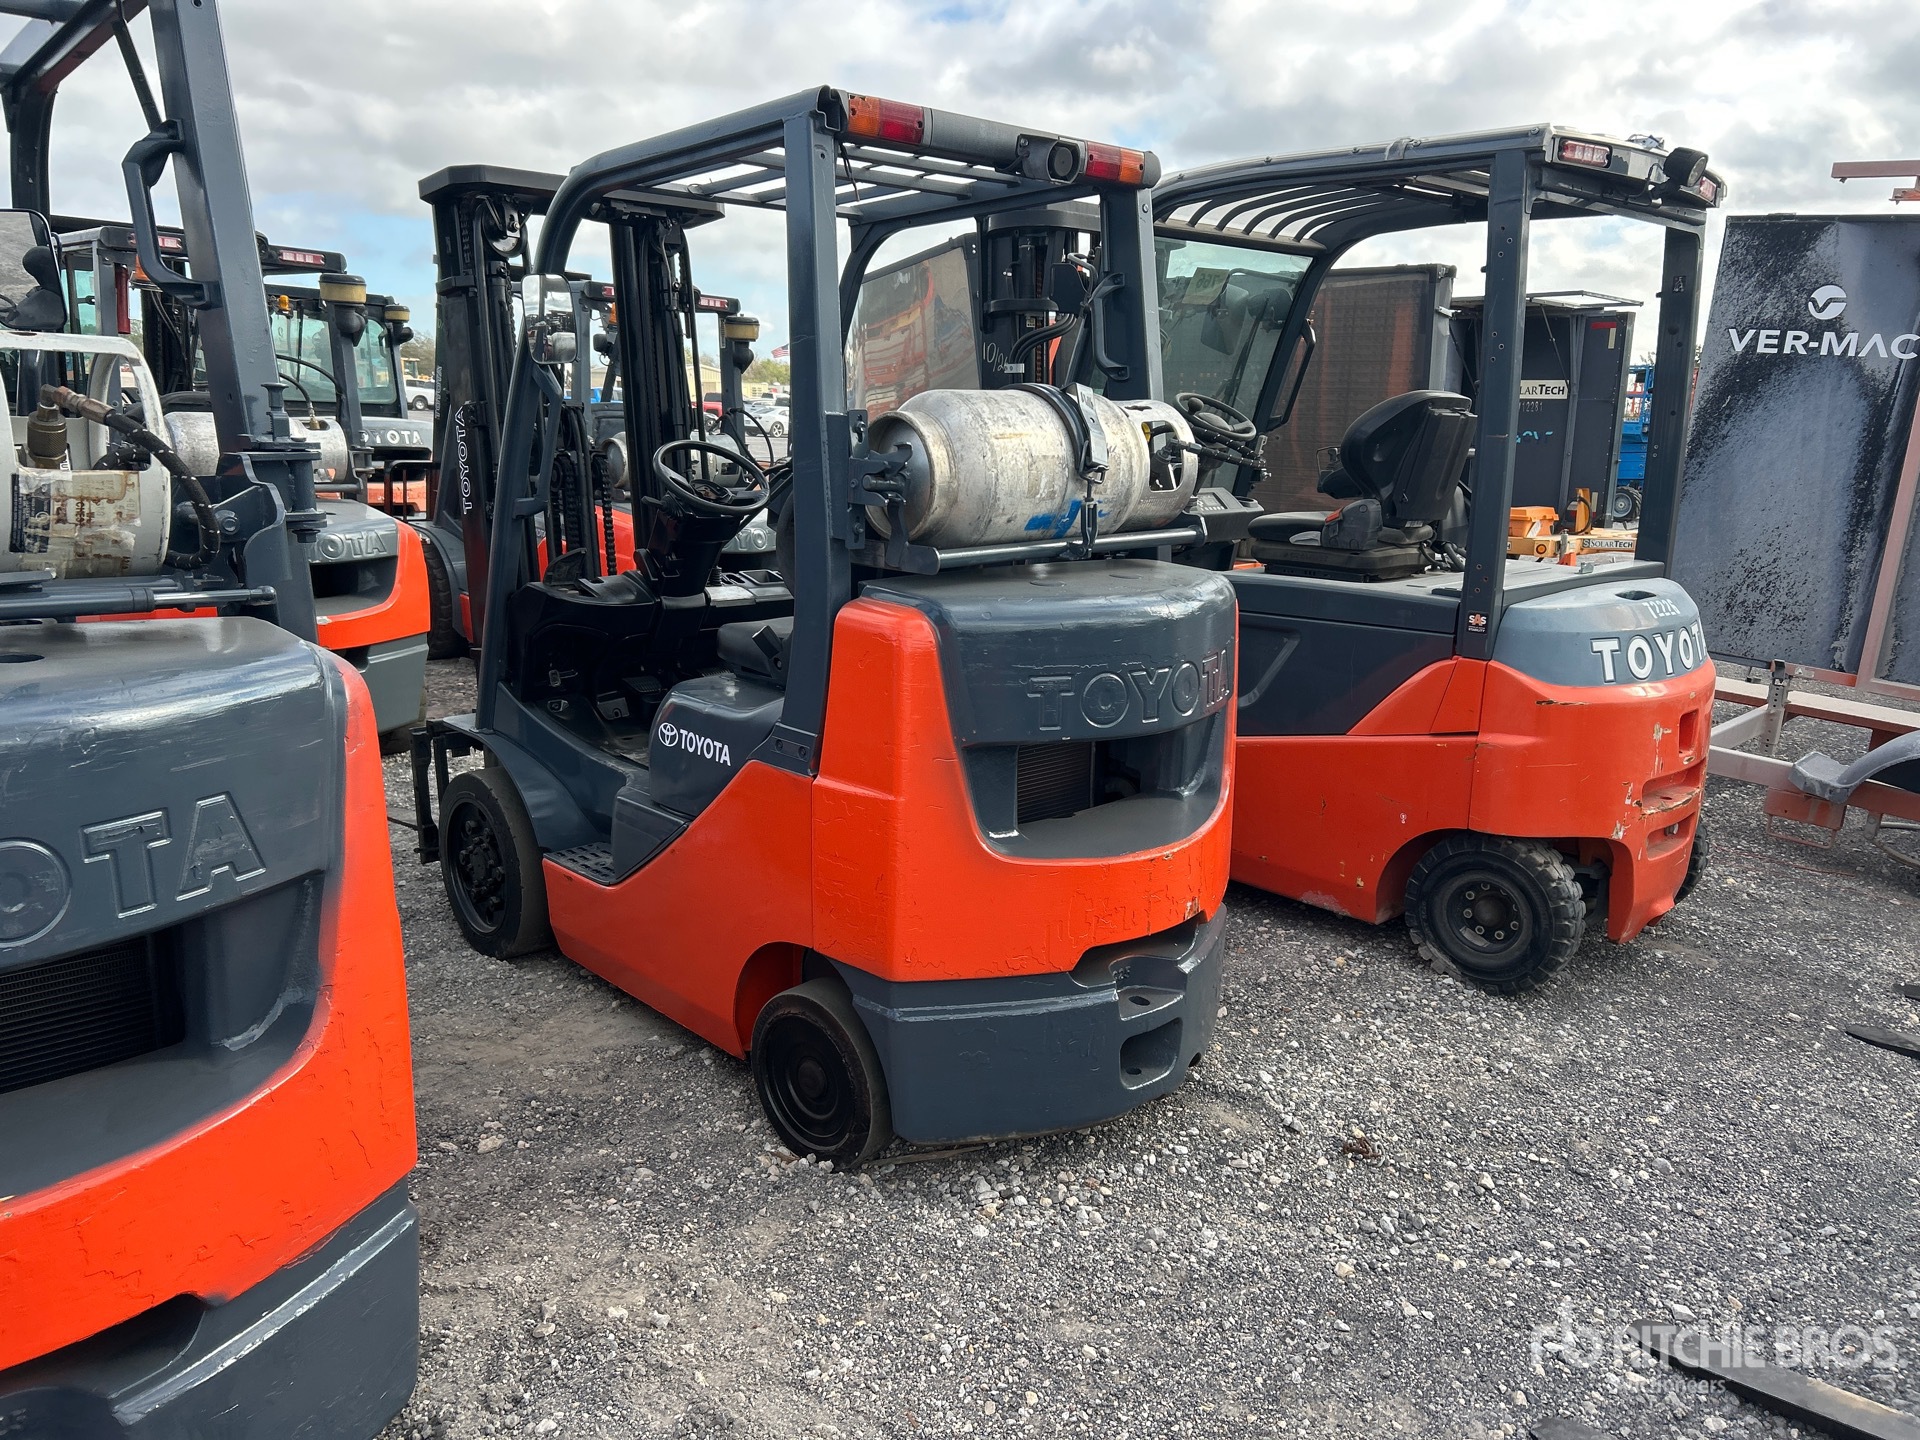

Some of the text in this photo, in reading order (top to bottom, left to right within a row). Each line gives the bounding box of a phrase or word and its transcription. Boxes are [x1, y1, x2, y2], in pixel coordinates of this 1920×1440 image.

[1728, 328, 1920, 360] VER-MAC
[434, 366, 443, 419] TOYOTA
[359, 429, 424, 445] OYOTA
[454, 405, 473, 515] TOYOTA
[318, 529, 387, 560] OTA
[1468, 613, 1487, 626] SAS
[1027, 649, 1230, 731] TOYOTA
[679, 728, 731, 767] TOYOTA
[0, 790, 267, 948] OTA
